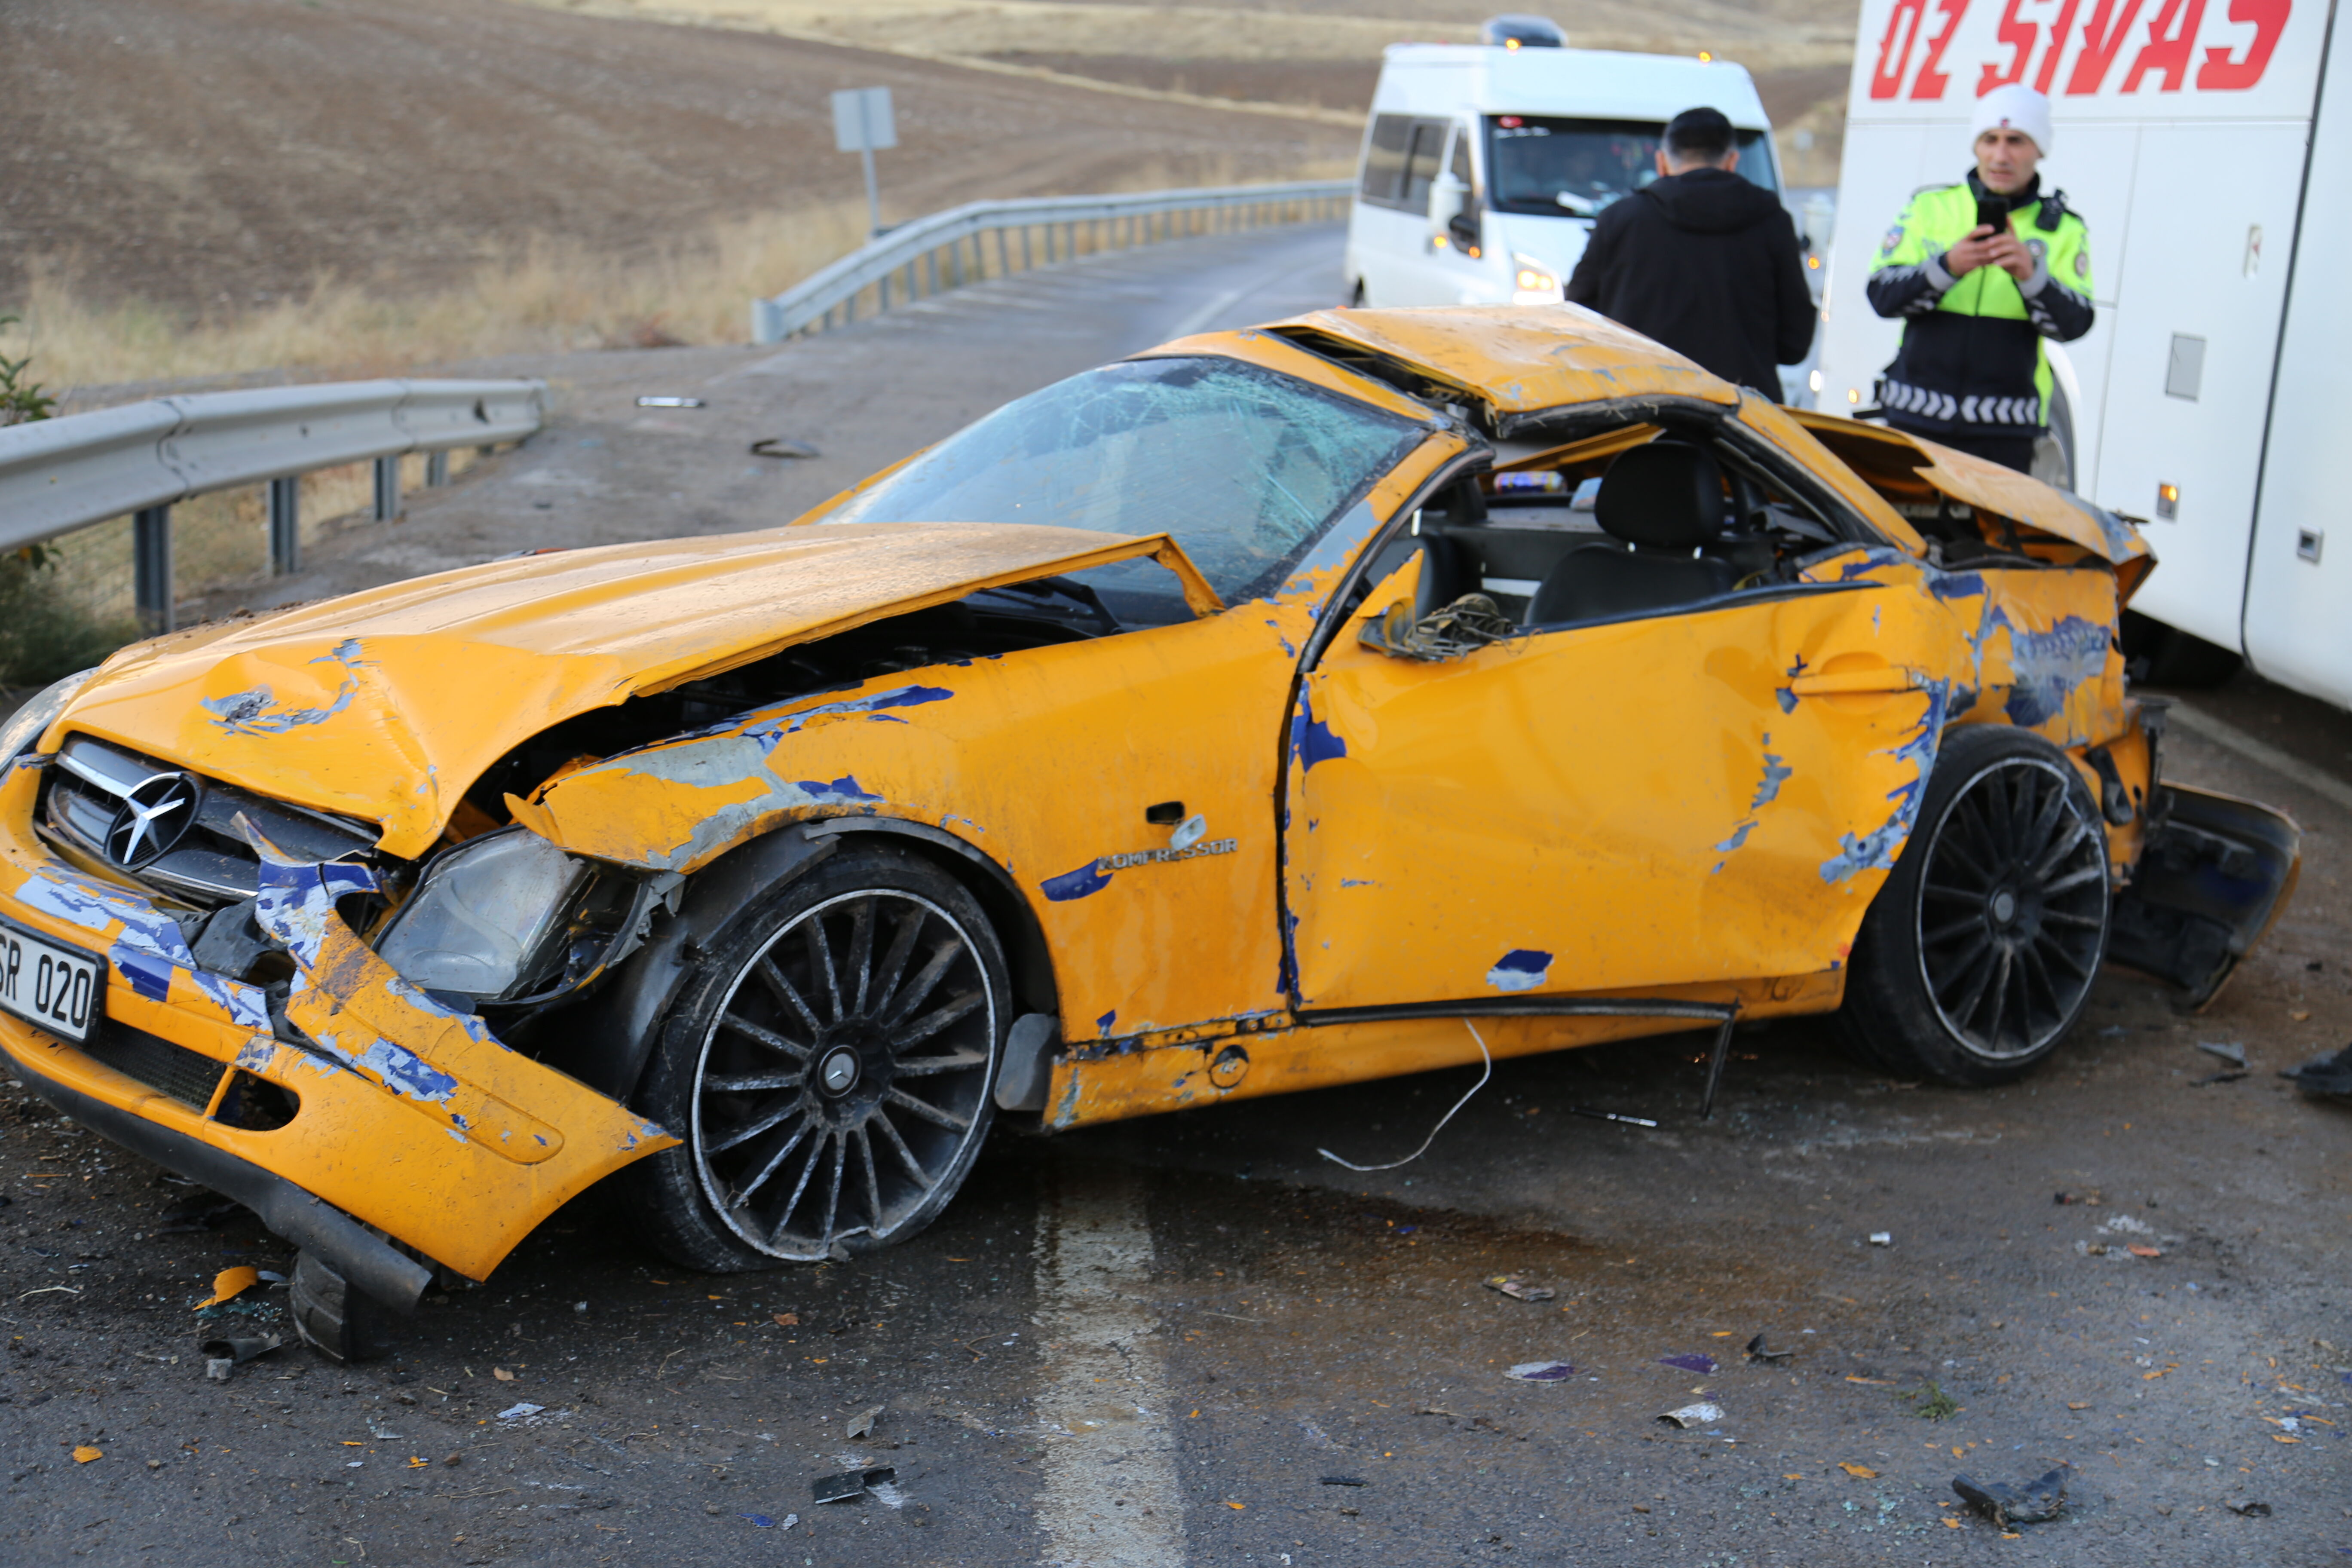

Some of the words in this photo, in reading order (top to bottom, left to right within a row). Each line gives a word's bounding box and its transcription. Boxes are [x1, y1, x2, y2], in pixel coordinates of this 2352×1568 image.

[1976, 0, 2294, 97] SIVAS
[1098, 838, 1238, 871] KOMPRESSOR
[35, 954, 90, 1029] 020
